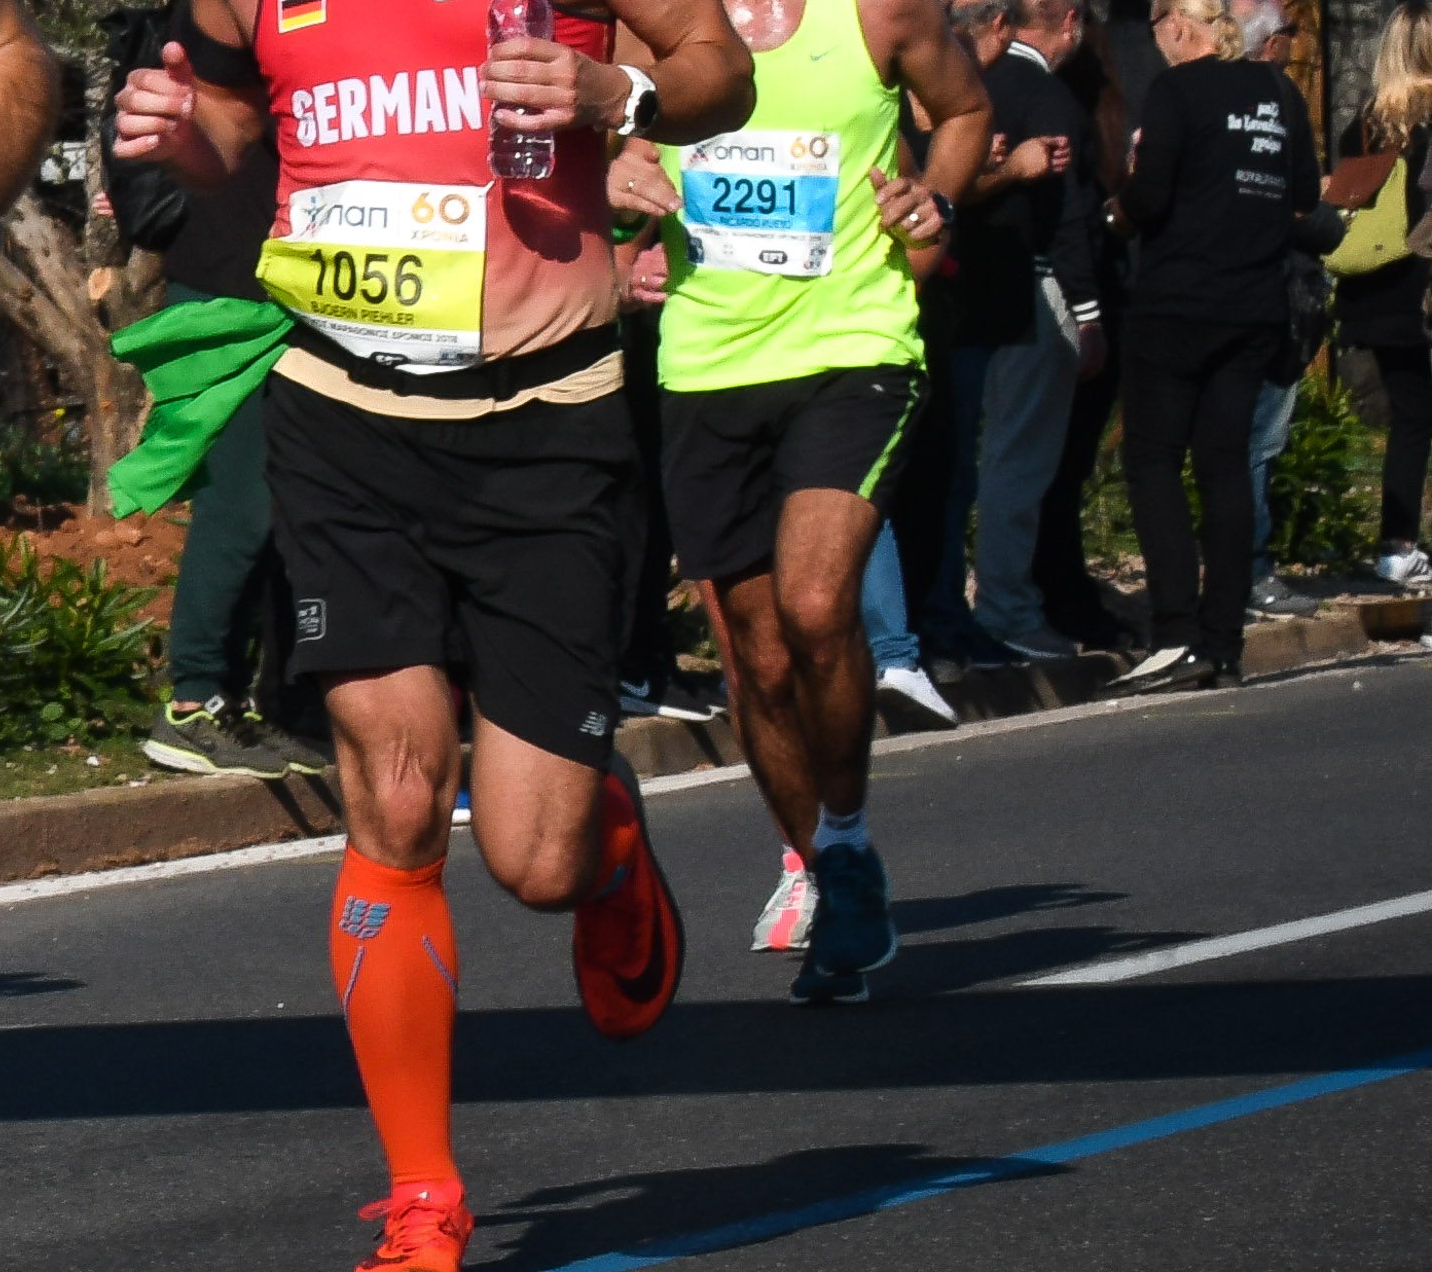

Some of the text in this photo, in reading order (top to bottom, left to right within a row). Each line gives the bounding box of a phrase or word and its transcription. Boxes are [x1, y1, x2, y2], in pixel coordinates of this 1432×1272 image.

[791, 136, 829, 158] 60
[411, 192, 470, 225] 60
[712, 177, 795, 215] 2291
[310, 249, 423, 306] 1056
